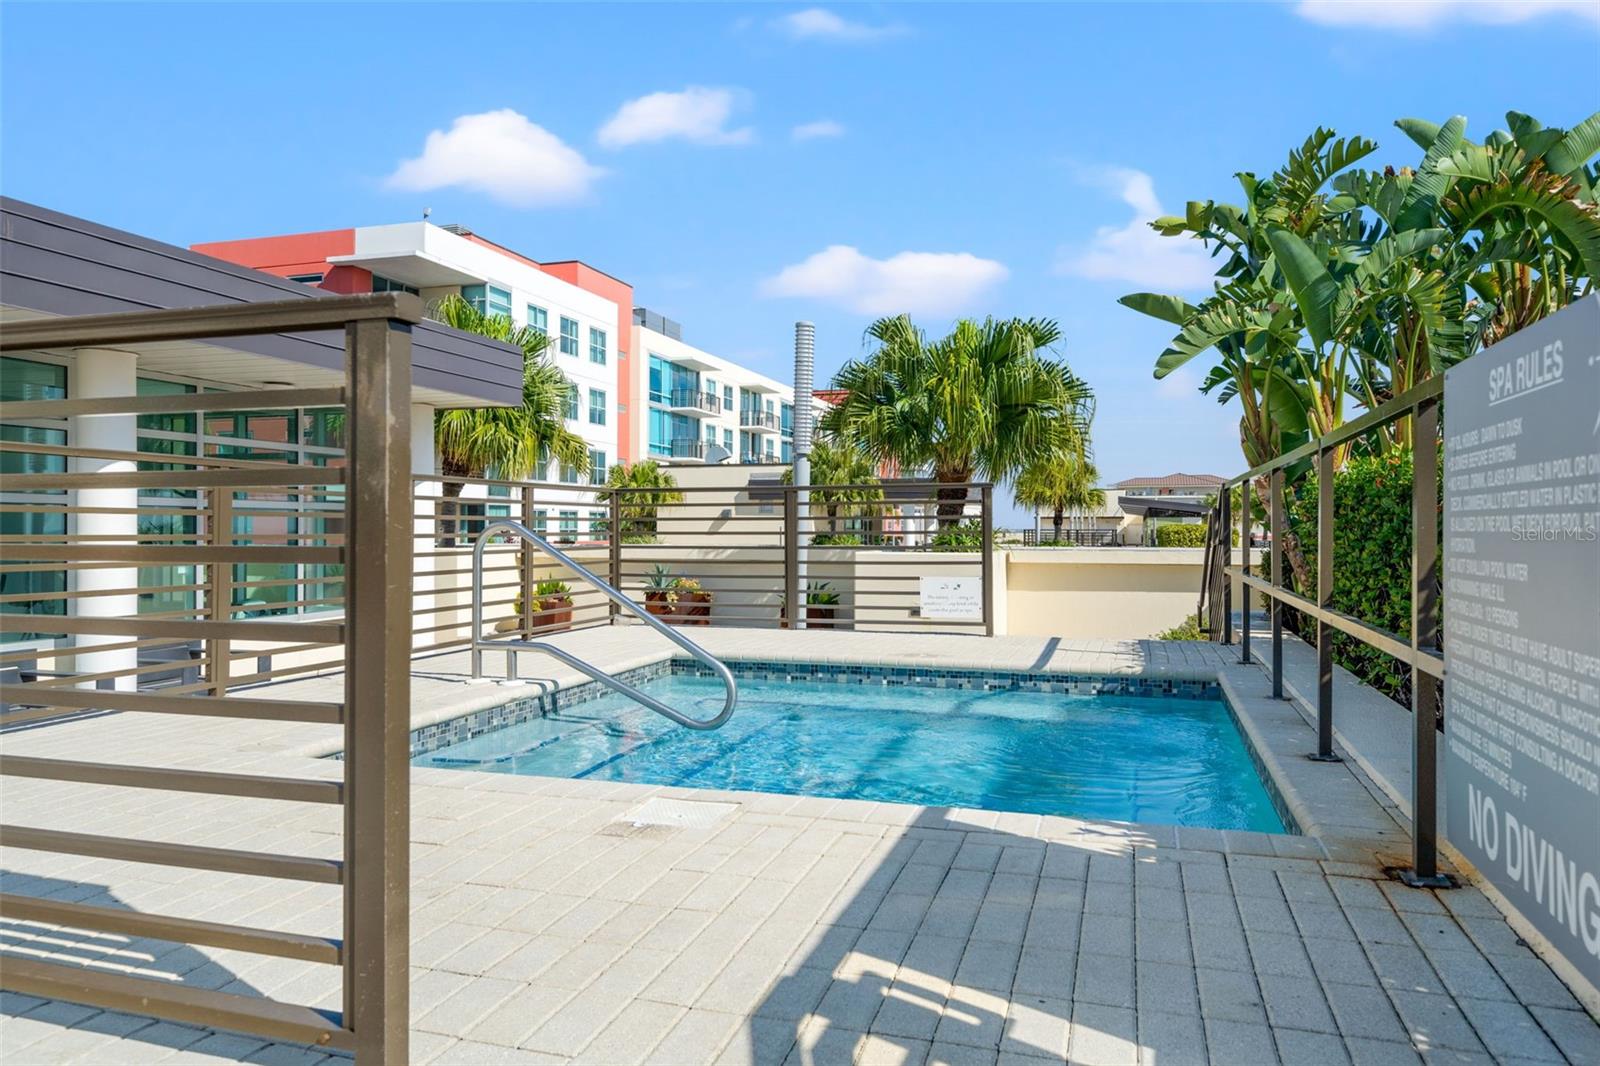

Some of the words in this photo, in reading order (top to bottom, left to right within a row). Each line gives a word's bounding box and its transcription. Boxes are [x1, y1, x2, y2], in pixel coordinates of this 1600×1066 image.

[1489, 362, 1513, 402] SPA
[1516, 339, 1564, 391] RULES
[1480, 424, 1496, 444] DAWN
[1505, 417, 1522, 438] DUSK
[1469, 449, 1487, 468] BEFORE
[1488, 443, 1516, 464] ENTERING
[1487, 468, 1505, 486] GLASS
[1515, 462, 1543, 483] ANIMALS
[1553, 457, 1573, 479] POOL
[1575, 455, 1587, 476] OR
[1501, 490, 1528, 508] BOTTLED
[1530, 487, 1553, 507] WATER
[1564, 483, 1597, 505] PLASTIC
[1495, 516, 1511, 531] POOL
[1545, 514, 1560, 530] FOR
[1561, 513, 1581, 530] POOL
[1490, 561, 1505, 579] POOL
[1506, 563, 1528, 581] WATER
[1491, 607, 1518, 629] PERSONS
[1488, 629, 1511, 651] TWELVE
[1511, 635, 1528, 656] MUST
[1529, 640, 1548, 662] HAVE
[1549, 646, 1573, 670] ADULT
[1485, 672, 1506, 696] PEOPLE
[1507, 681, 1526, 705] USING
[1494, 653, 1513, 675] SMALL
[1548, 671, 1577, 699] PEOPLE
[1497, 699, 1516, 724] CAUSE
[1516, 708, 1559, 746] DROWSINESS
[1561, 729, 1592, 762] SHOULD
[1476, 710, 1498, 738] WITHOUT
[1499, 722, 1515, 748] FIRST
[1516, 731, 1557, 771] CONSULTING
[1565, 757, 1599, 795] DOCTOR
[1488, 740, 1512, 770] MINUTES
[1472, 750, 1509, 792] TEMPERATURE
[1469, 784, 1499, 861] NO
[1505, 811, 1600, 960] DIVING
